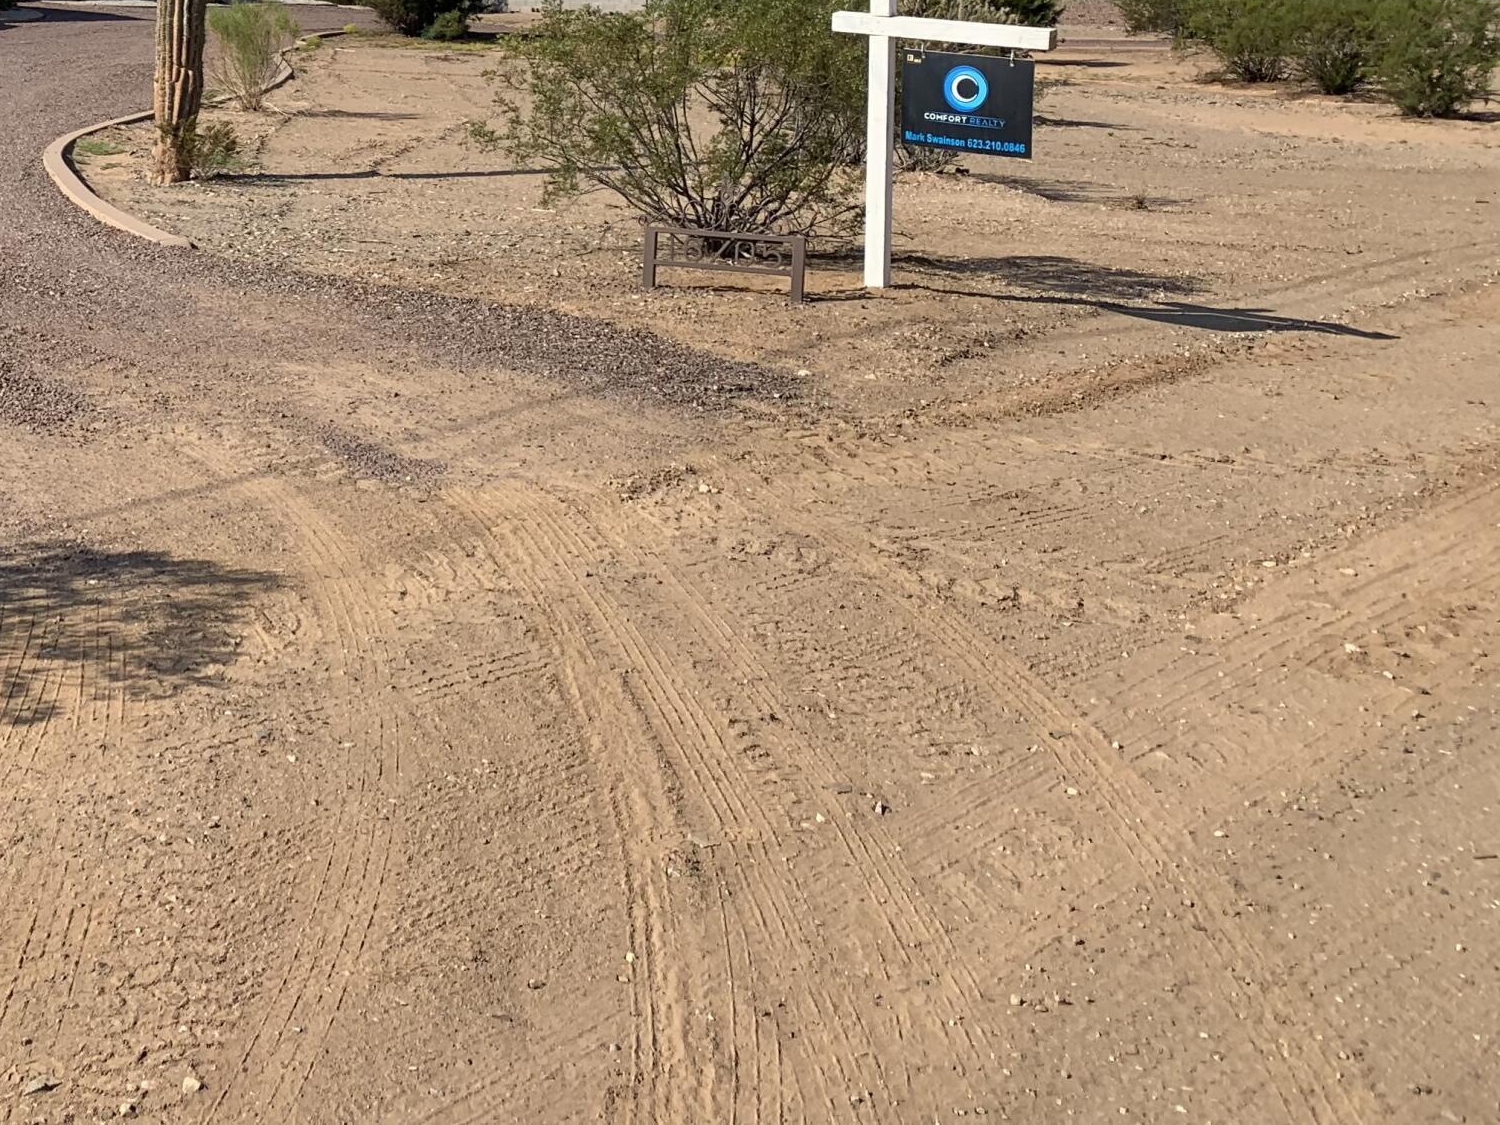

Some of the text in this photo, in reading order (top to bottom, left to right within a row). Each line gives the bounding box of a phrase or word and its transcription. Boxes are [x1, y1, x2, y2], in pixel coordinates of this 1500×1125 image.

[924, 112, 1005, 127] COMFORT REALTY
[905, 130, 1026, 153] Mark Swainson 623.210.0846
[667, 234, 782, 268] 16705
